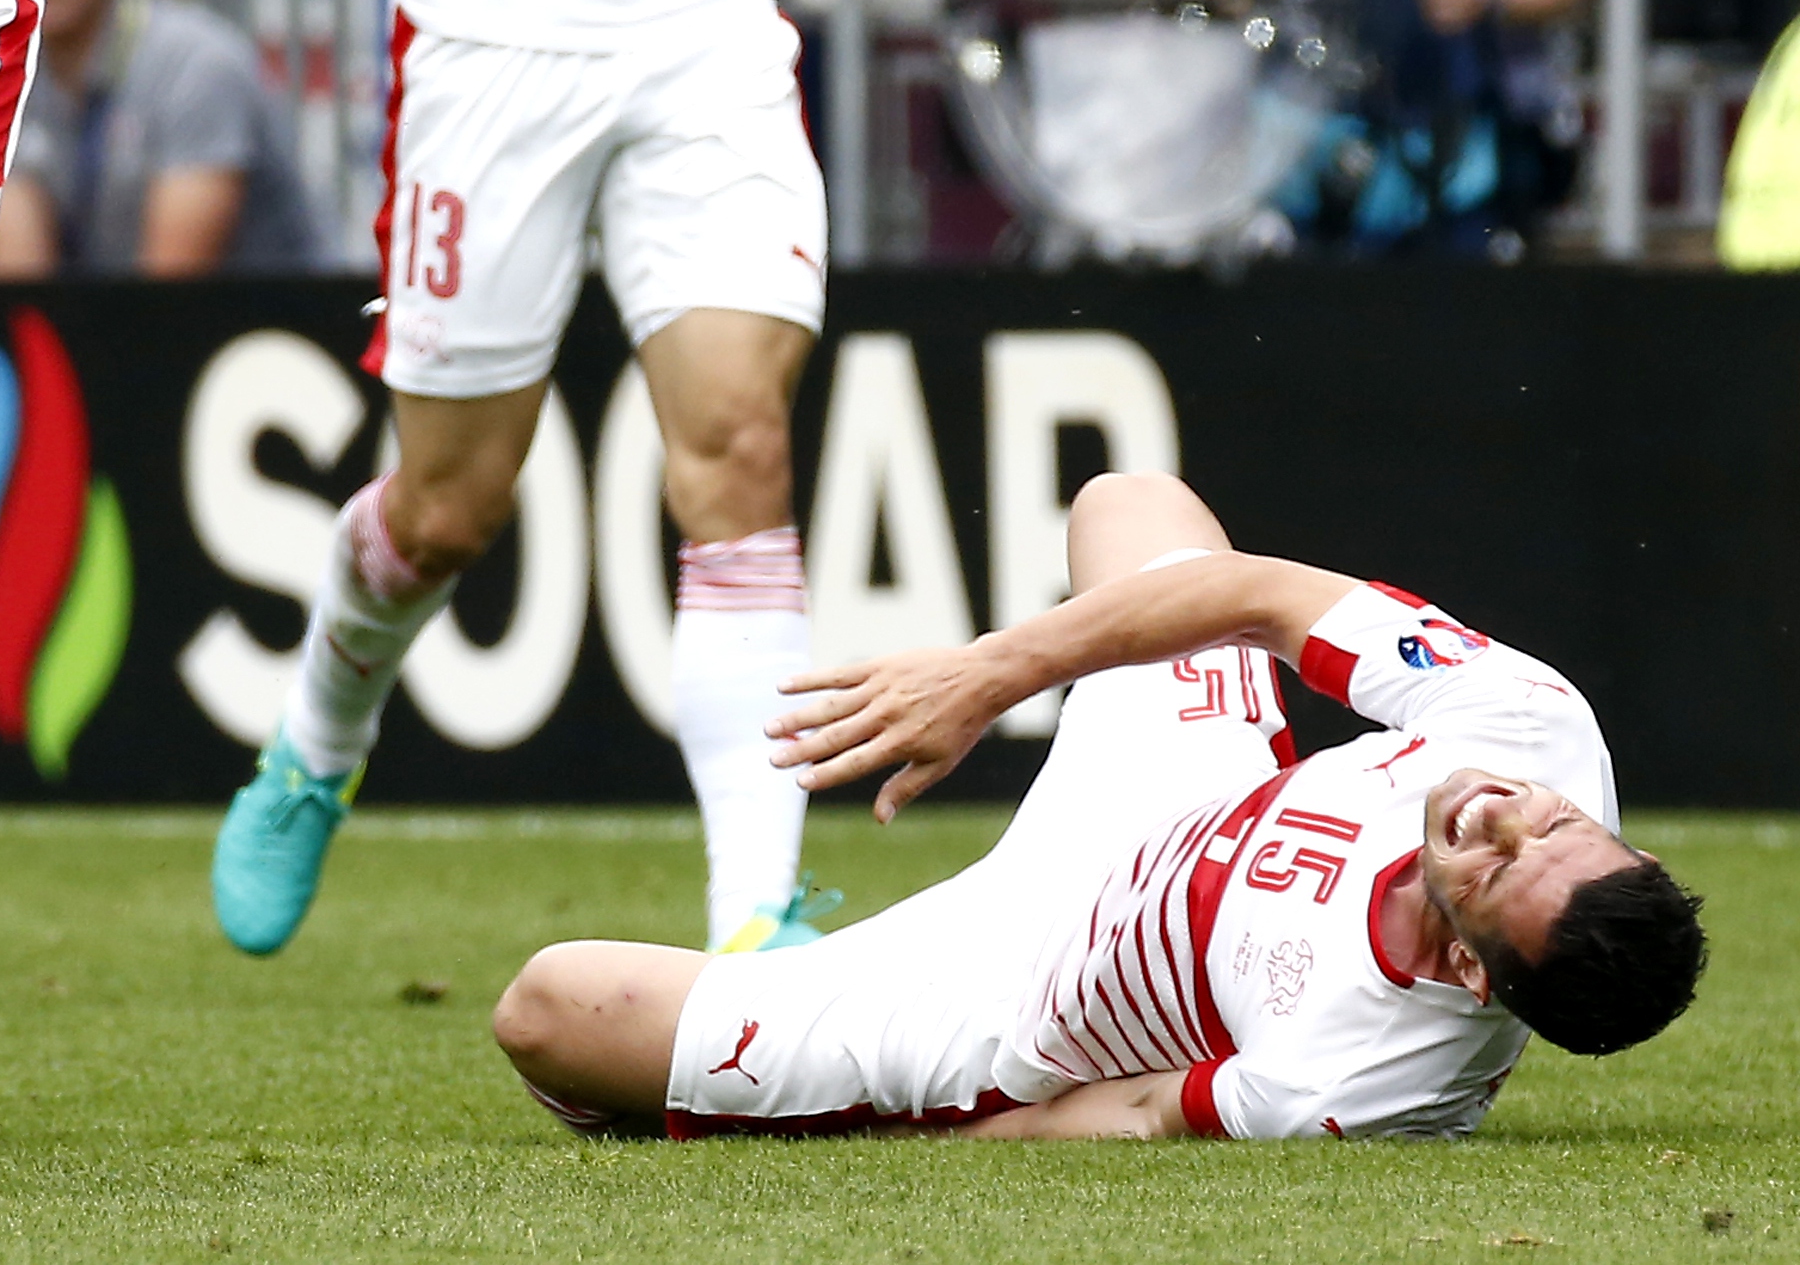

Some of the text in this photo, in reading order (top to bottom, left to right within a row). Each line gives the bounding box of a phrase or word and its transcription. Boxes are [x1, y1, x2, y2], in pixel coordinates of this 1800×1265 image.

[406, 183, 465, 299] 13
[1173, 646, 1262, 723] 15
[1246, 807, 1363, 905] 15
